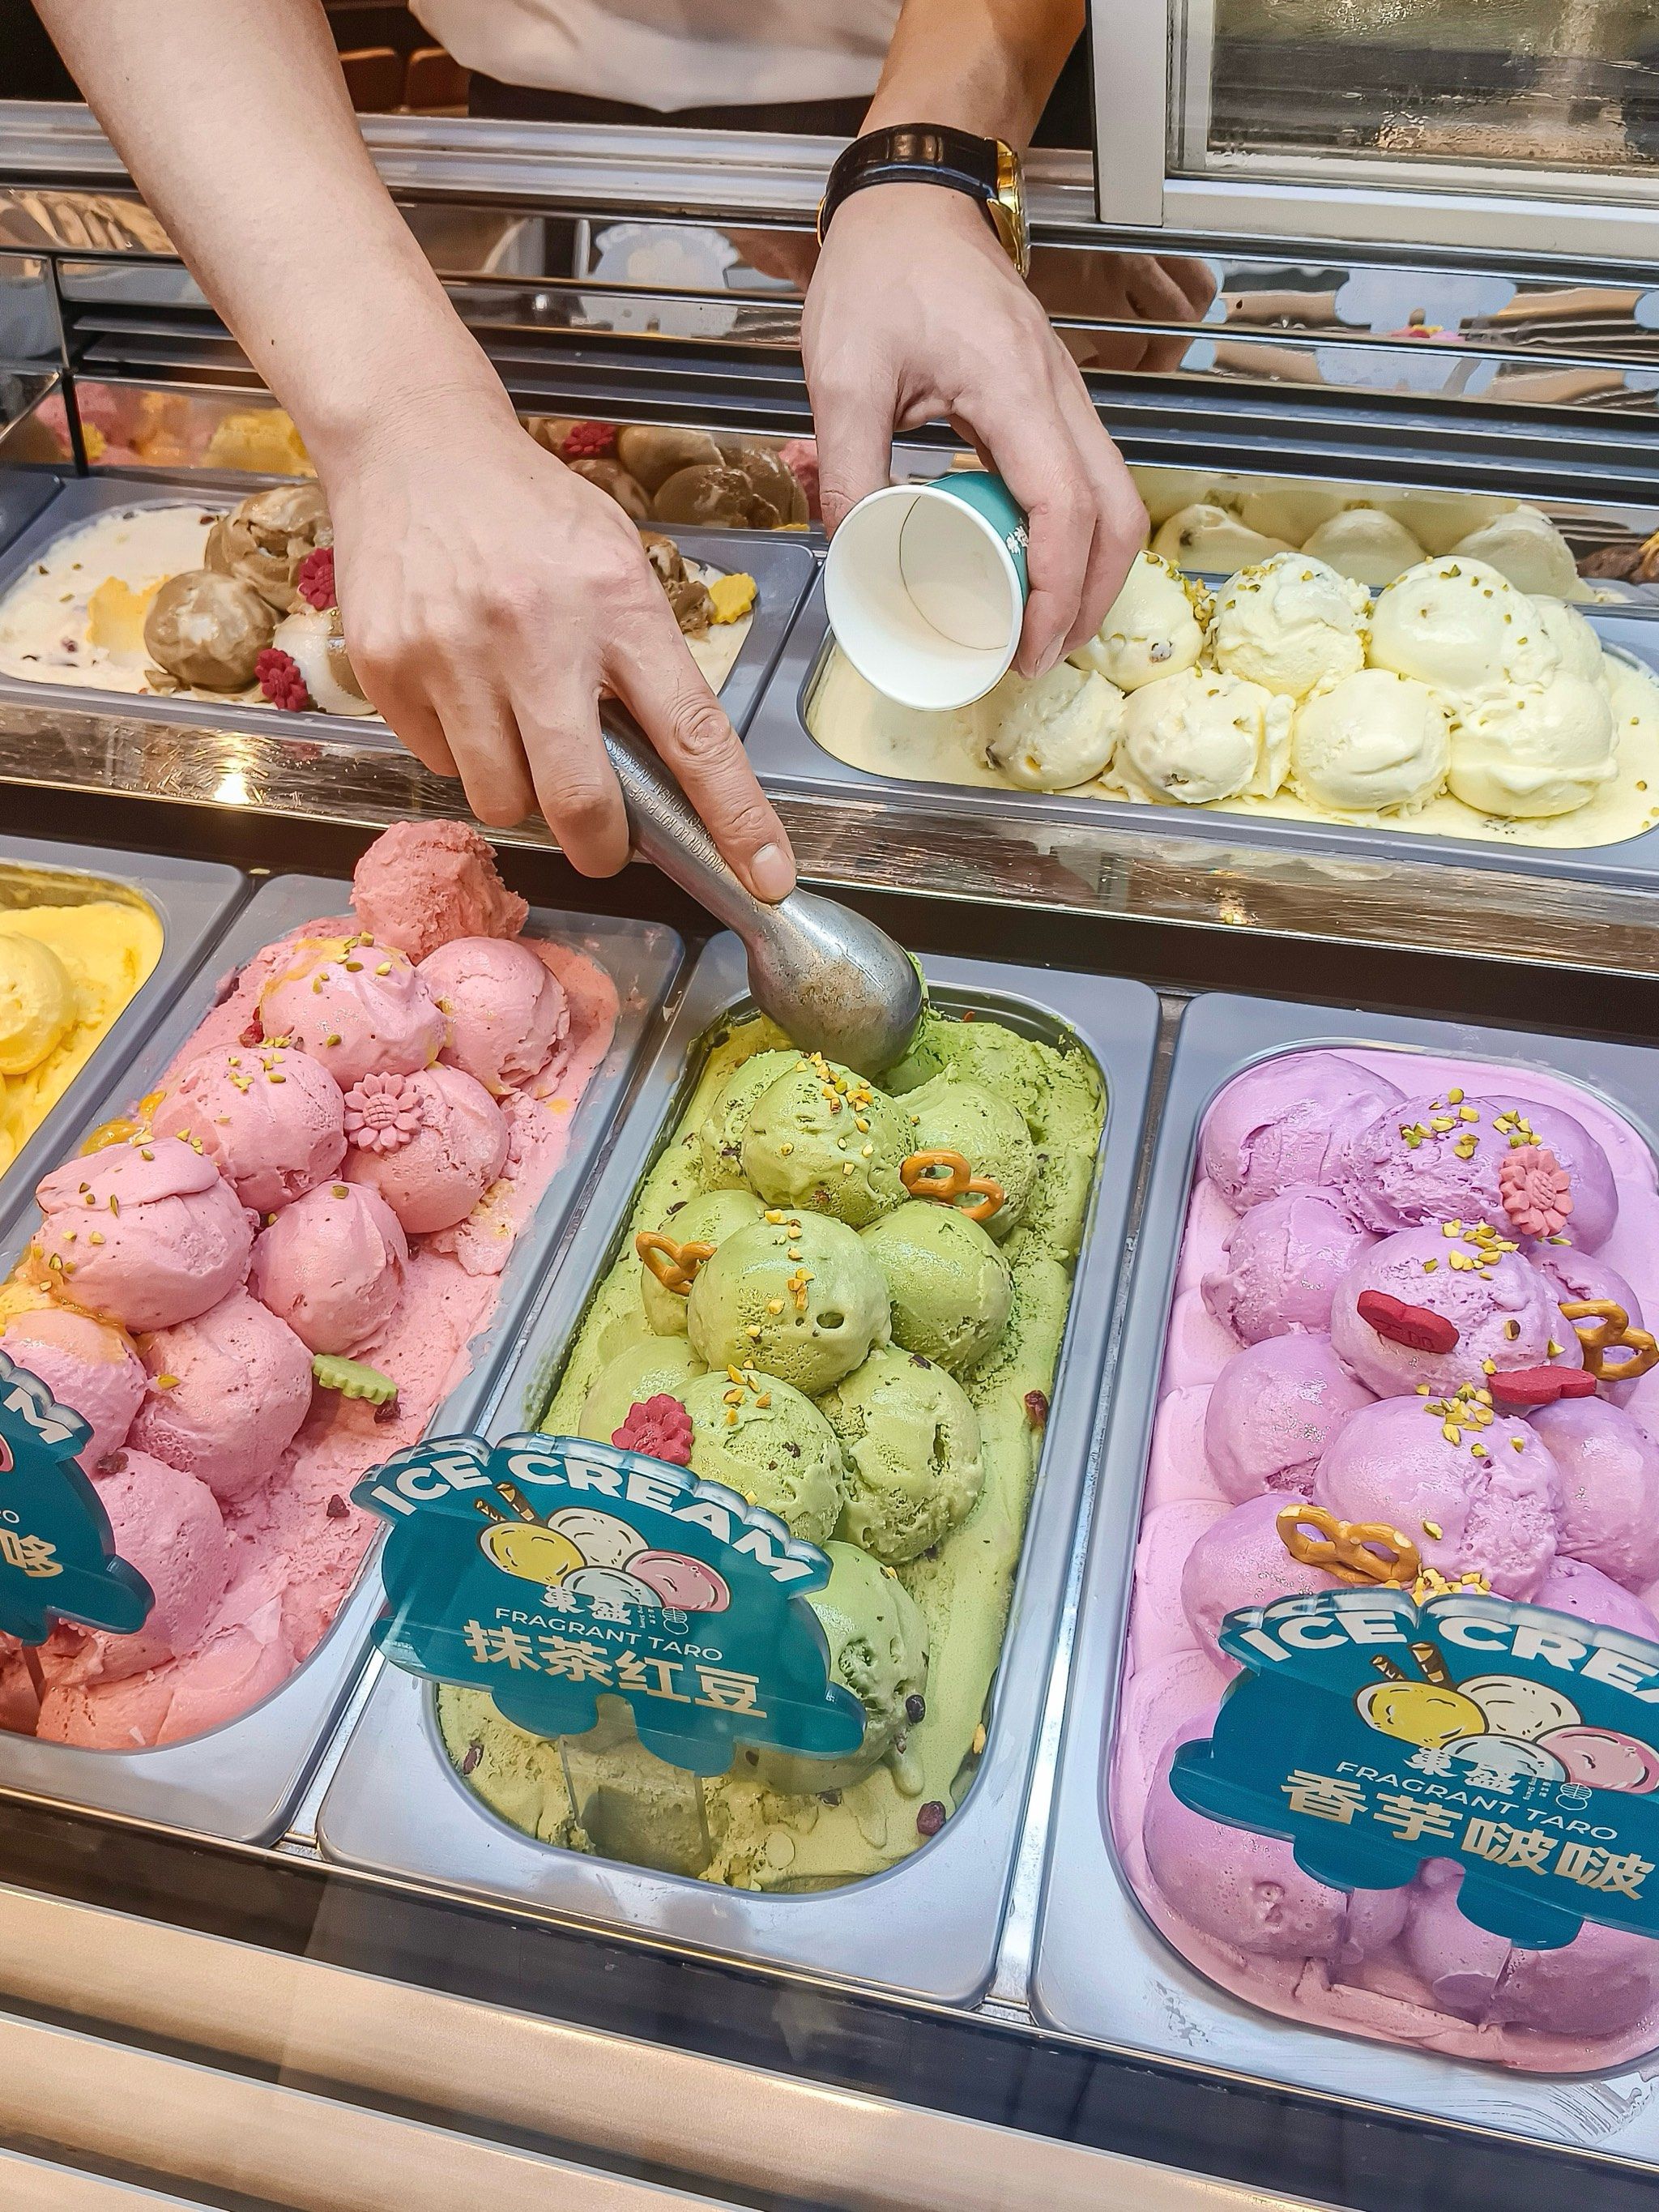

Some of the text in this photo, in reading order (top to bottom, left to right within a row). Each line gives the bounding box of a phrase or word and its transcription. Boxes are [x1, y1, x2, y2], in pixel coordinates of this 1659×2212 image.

[370, 1454, 814, 1582] ICE CREAM
[463, 1619, 768, 1719] 抹茶红豆
[494, 1608, 642, 1646] FRAGRANT
[647, 1636, 723, 1661] TARO
[1239, 1610, 1408, 1662] ICE
[1280, 1769, 1656, 1901] 香芋啵啵
[1336, 1761, 1520, 1814] FRAGRANT
[1526, 1808, 1618, 1840] TARO
